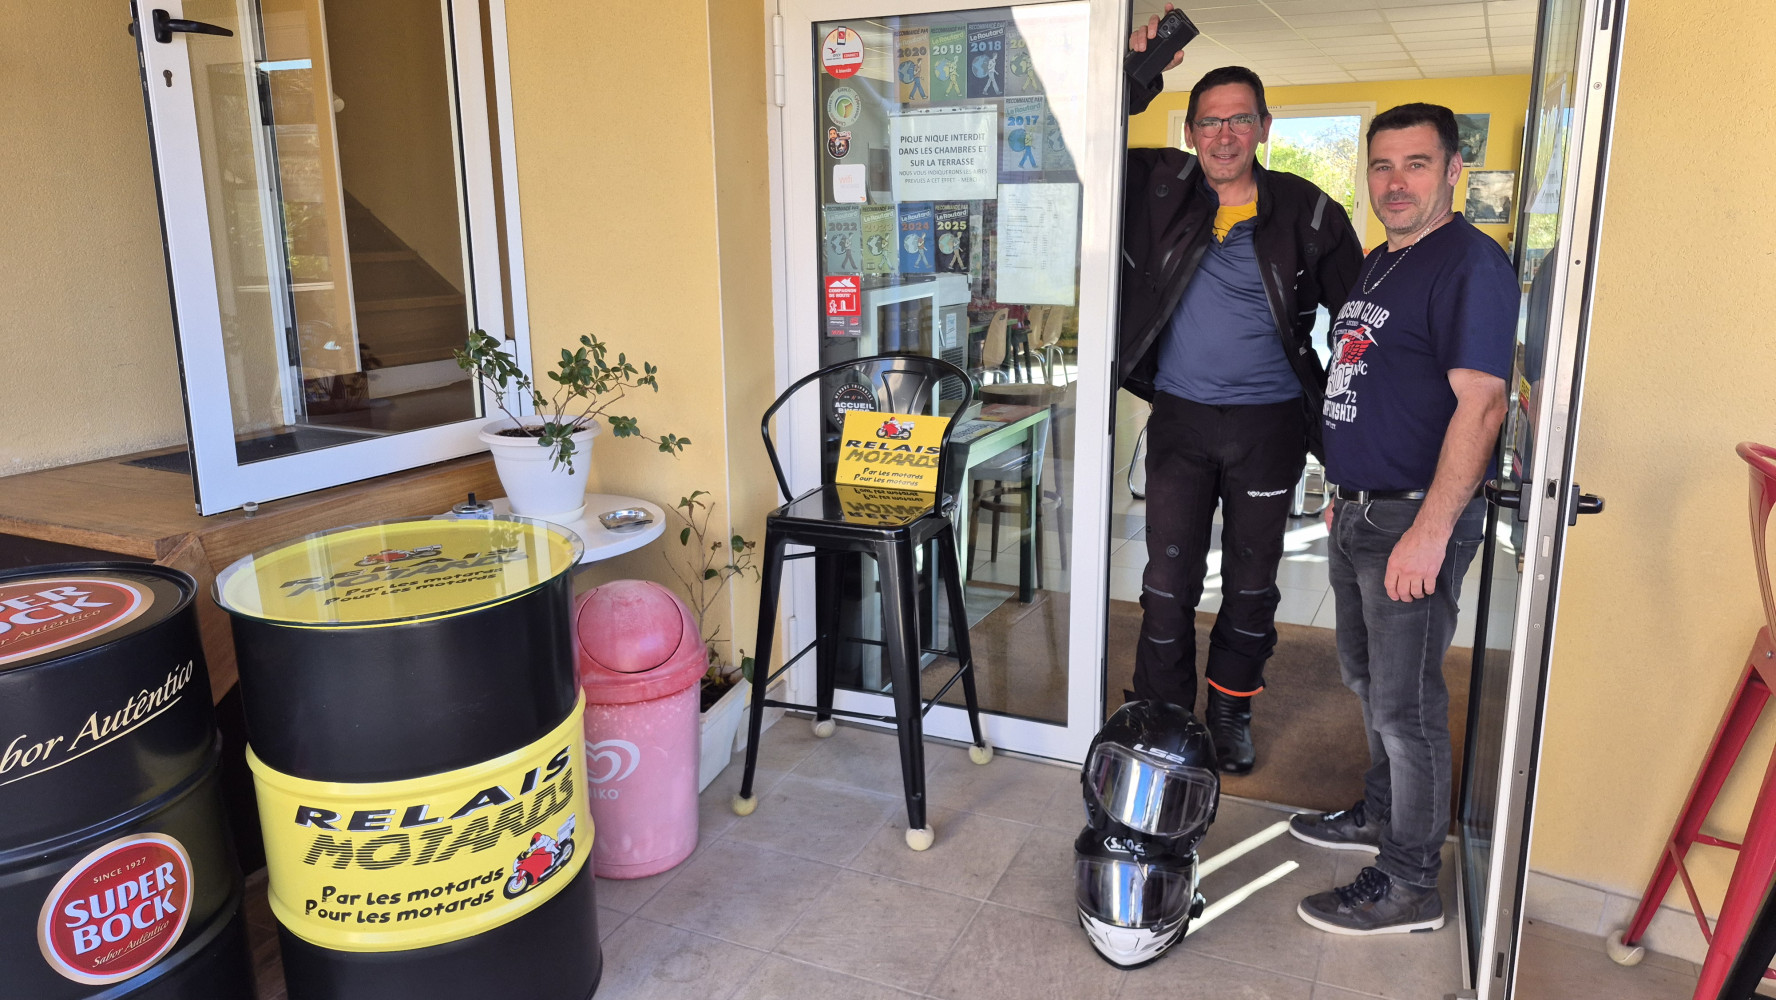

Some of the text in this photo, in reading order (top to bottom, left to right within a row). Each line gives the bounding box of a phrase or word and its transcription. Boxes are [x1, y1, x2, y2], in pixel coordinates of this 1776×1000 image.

[977, 28, 1004, 39] Routard
[897, 46, 927, 58] 2020
[932, 44, 963, 56] 2019
[970, 40, 1002, 52] 2018
[1008, 116, 1040, 126] 2017
[924, 134, 948, 142] NIQUE
[950, 133, 985, 142] INTERDIT
[920, 147, 932, 155] LES
[934, 146, 976, 154] CHAMBRES
[910, 159, 925, 167] SUR
[938, 158, 974, 166] TERRASSE
[870, 211, 893, 220] Routard
[943, 210, 967, 219] Routard
[829, 222, 857, 232] 2022
[902, 222, 929, 232] 2024
[937, 221, 967, 230] 2025
[1361, 302, 1390, 328] CLUB
[1352, 360, 1368, 376] NYC
[1345, 390, 1357, 404] 72
[835, 402, 874, 410] ACCUEIL
[845, 440, 940, 454] RELAIS
[845, 449, 940, 468] MOTARDS
[886, 478, 918, 486] motards
[892, 471, 923, 480] motards
[280, 546, 518, 588] RELAIS
[286, 552, 529, 597] MOTARDS
[345, 585, 384, 596] Par
[424, 568, 502, 583] motards
[324, 593, 376, 605] Pour
[416, 574, 496, 590] motards
[67, 660, 193, 752] Autêntico
[1133, 743, 1186, 765] LS2
[295, 744, 571, 832] RELAIS
[300, 767, 574, 870] MOTARDS
[93, 857, 146, 884] SINCE 1927
[321, 886, 361, 905] Par
[407, 867, 504, 902] motards
[64, 862, 176, 928] SUPER
[305, 899, 352, 922] Pour
[396, 889, 494, 922] motards
[73, 888, 177, 955] BOCK
[92, 920, 169, 968] Sabor Autêntico
